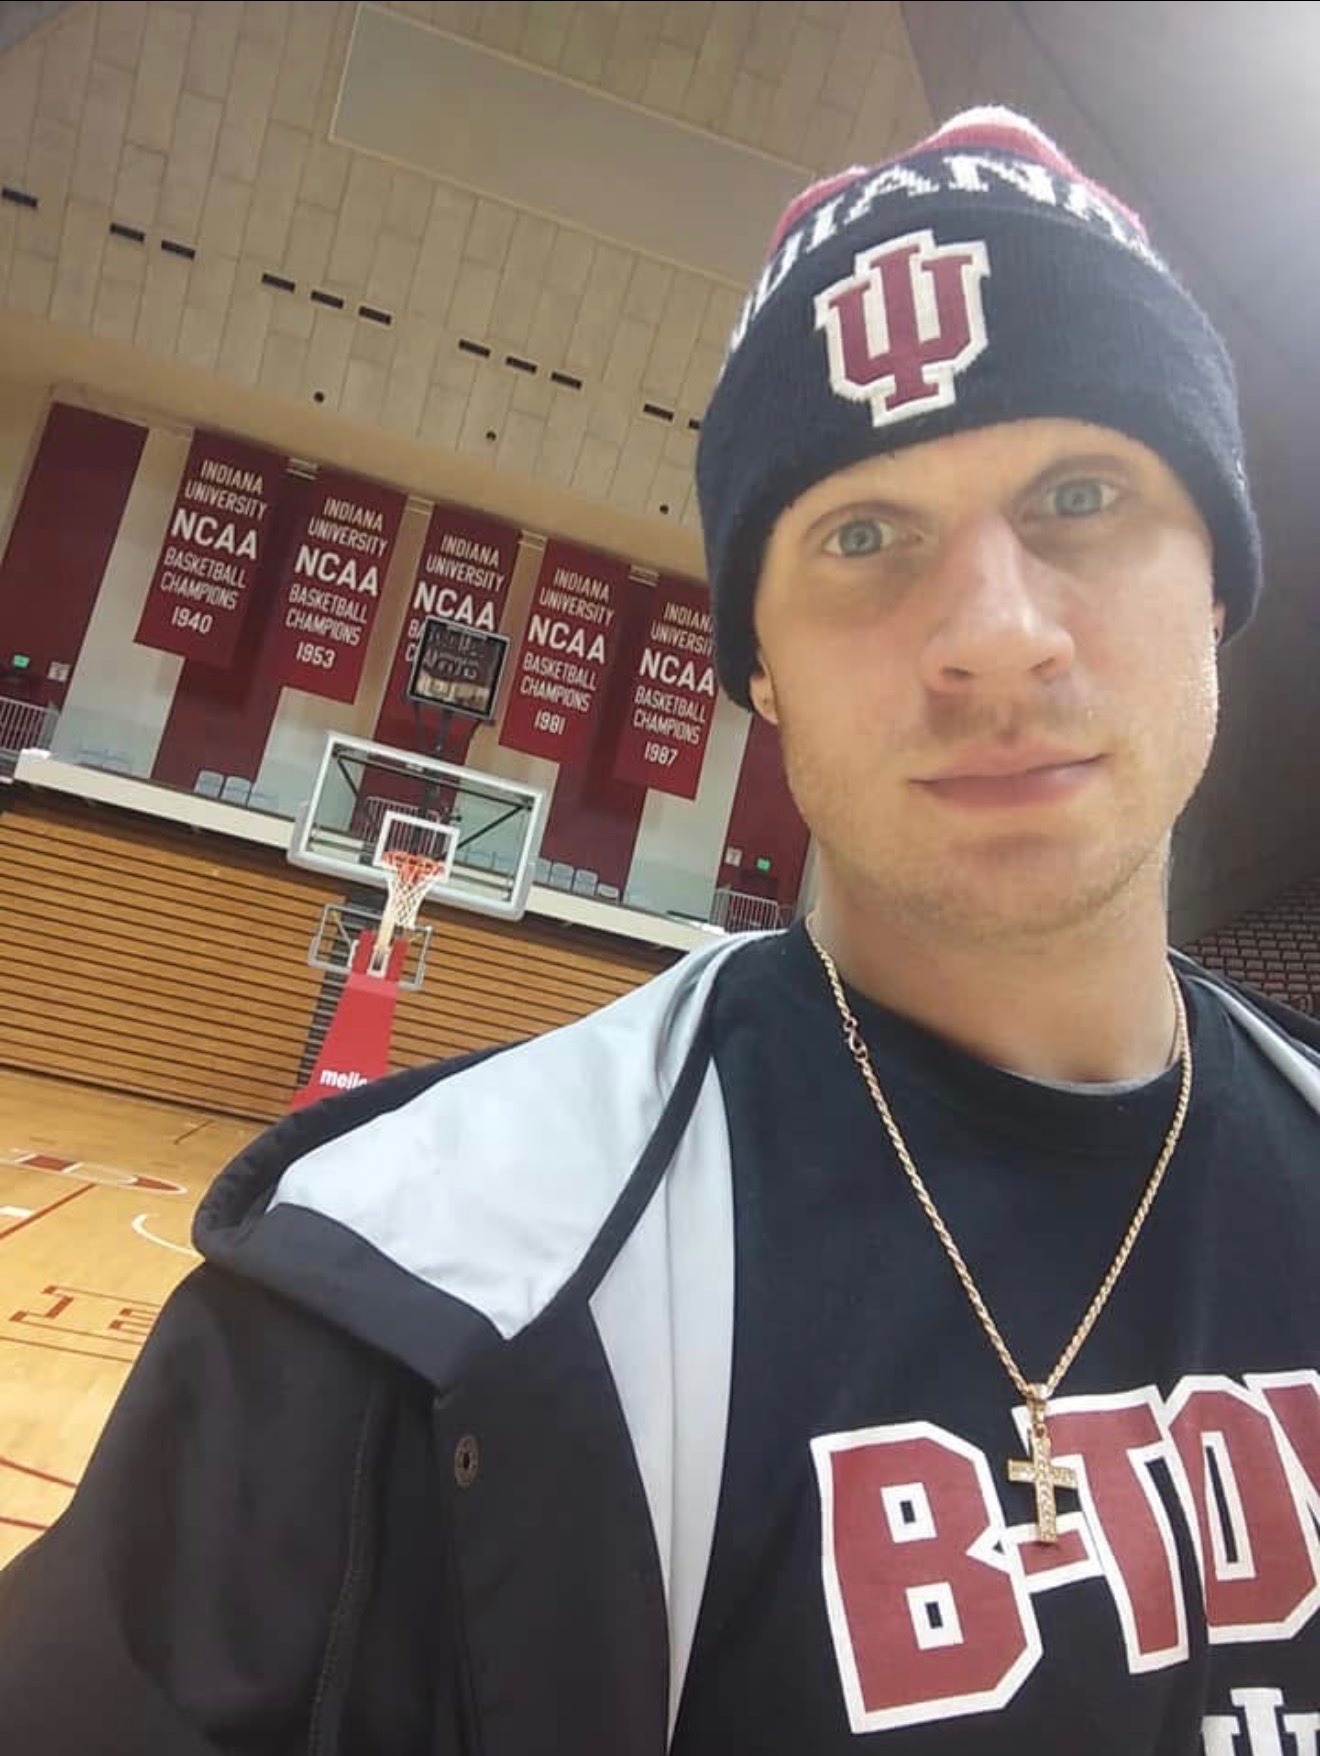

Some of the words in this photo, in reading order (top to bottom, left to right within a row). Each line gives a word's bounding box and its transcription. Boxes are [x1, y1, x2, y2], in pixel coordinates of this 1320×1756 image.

[200, 459, 264, 495] INDIANA
[184, 481, 267, 521] UNIVERSITY
[323, 498, 384, 532] INDIANA
[171, 508, 258, 560] NCAA
[307, 517, 388, 556] UNIVERSITY
[441, 535, 500, 569] INDIANA
[163, 547, 247, 589] BASKETBALL
[294, 545, 378, 597] NCAA
[425, 555, 504, 593] UNIVERSITY
[554, 568, 610, 602] INDIANA
[160, 572, 239, 610] CHAMPIONS
[289, 583, 368, 624] BASKETBALL
[413, 581, 496, 630] NCAA
[539, 587, 614, 626] UNIVERSITY
[171, 605, 213, 634] 1940
[285, 608, 362, 647] CHAMPIONS
[296, 641, 336, 670] 1953
[527, 614, 606, 664] NCAA
[523, 652, 597, 692] BASKETBALL
[638, 648, 716, 697] NCAA
[520, 677, 591, 713] CHAMPIONS
[634, 687, 706, 722] BASKETBALL
[534, 711, 566, 735] 1981
[633, 711, 701, 745] CHAMPIONS
[644, 742, 678, 767] 1987
